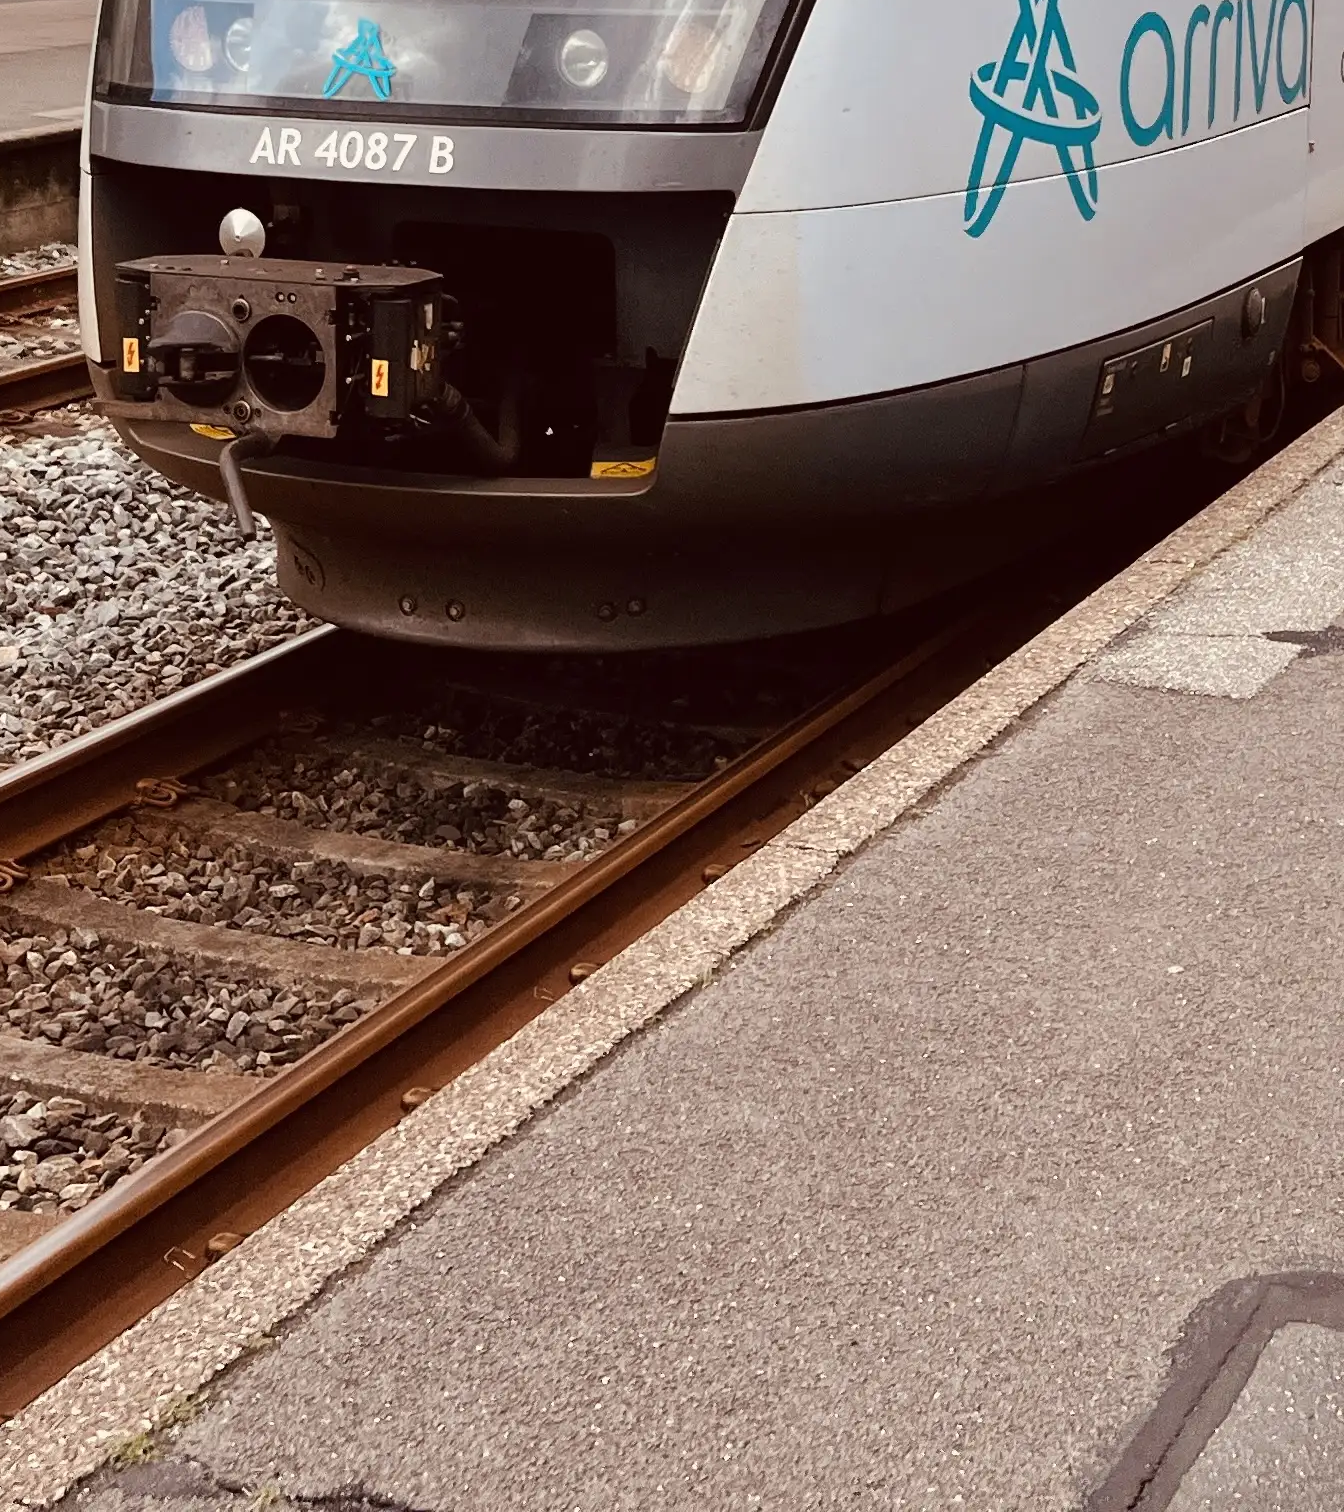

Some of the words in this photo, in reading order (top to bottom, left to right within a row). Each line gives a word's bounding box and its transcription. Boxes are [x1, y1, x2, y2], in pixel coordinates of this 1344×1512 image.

[248, 126, 302, 166] AR
[313, 129, 418, 171] 4087
[428, 135, 455, 174] B
